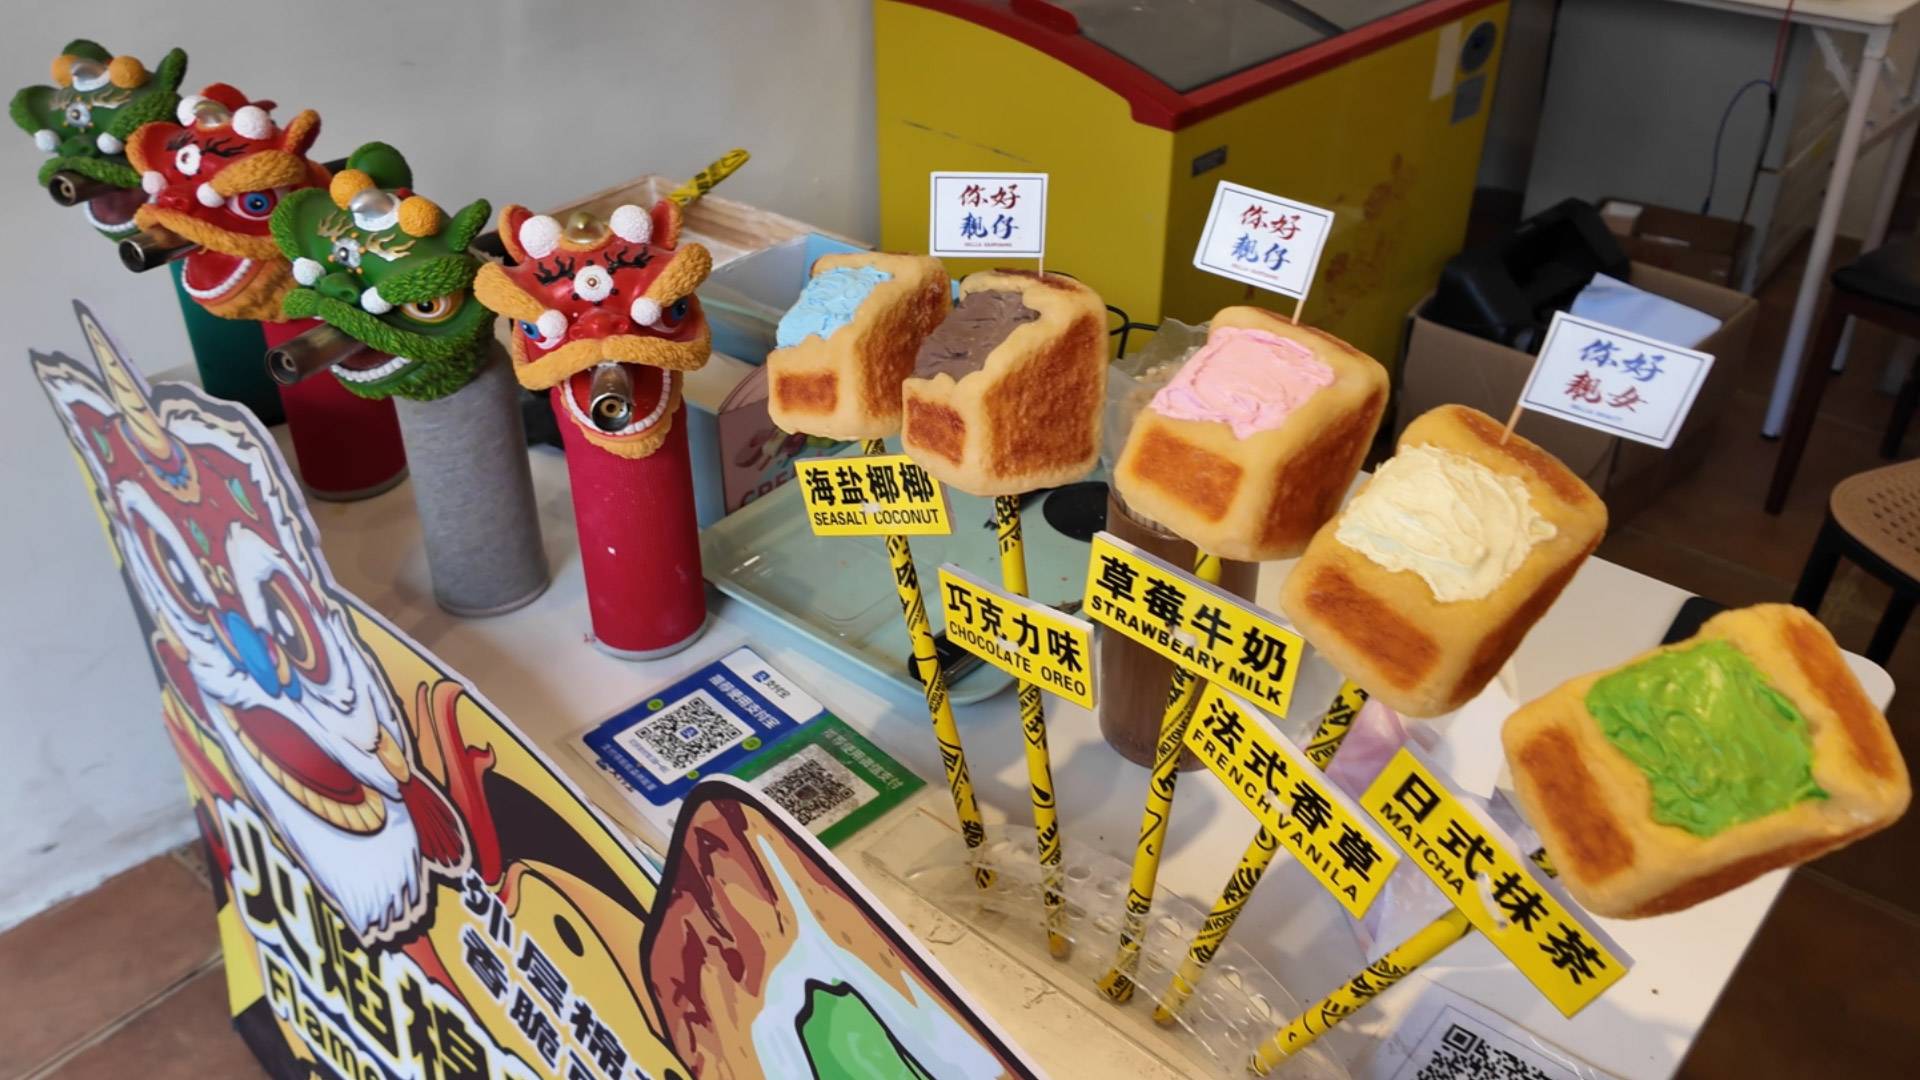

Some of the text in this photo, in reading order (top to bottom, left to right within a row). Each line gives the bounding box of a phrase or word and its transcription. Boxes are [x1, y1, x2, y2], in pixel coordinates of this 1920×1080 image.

[959, 183, 1021, 210] 你好
[1241, 204, 1302, 241] 你好
[1580, 338, 1666, 383] 你好
[804, 462, 935, 507] 海盐椰椰
[813, 508, 940, 527] SEASALT COCONUT
[945, 581, 1083, 673] 巧克力味
[949, 620, 1033, 675] CHOCOLATE
[1040, 665, 1087, 698] OREO
[1091, 595, 1284, 707] STRAWBEARY MILK
[1096, 554, 1288, 683] 草莓牛奶
[1192, 728, 1272, 814] FRENCH
[1276, 812, 1359, 903] VANILA
[1202, 697, 1384, 883] 法式香草
[1379, 801, 1466, 896] MATCHA
[1392, 771, 1607, 986] 日式抹茶
[463, 875, 650, 1080] 外层棉
